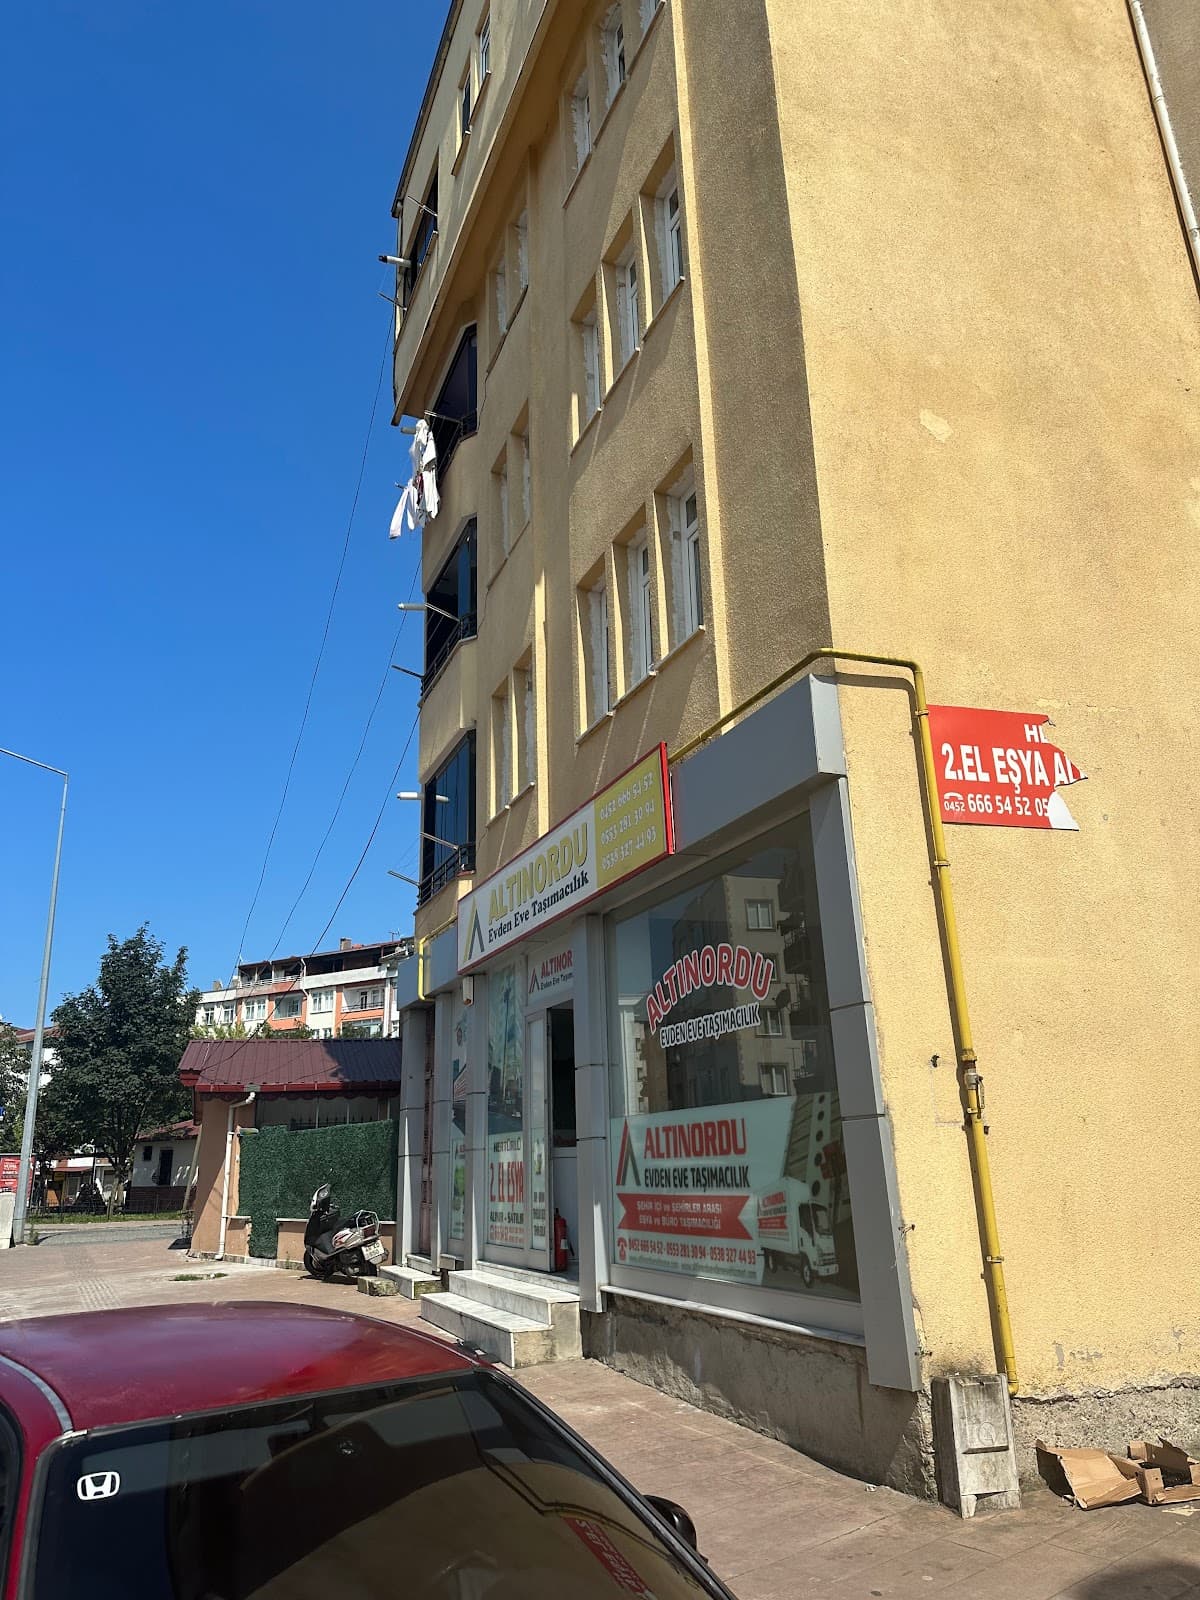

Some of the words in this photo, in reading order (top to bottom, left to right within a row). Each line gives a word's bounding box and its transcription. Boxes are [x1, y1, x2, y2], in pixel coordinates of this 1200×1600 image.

[941, 742, 990, 783] 2.EL
[991, 747, 1051, 794] EŞYA
[944, 801, 965, 812] 0452
[967, 793, 993, 814] 666
[995, 795, 1012, 815] 54
[1015, 797, 1032, 816] 52
[488, 822, 589, 926] ALTINORDU
[488, 919, 513, 943] Evden
[514, 910, 530, 929] Eve
[532, 870, 590, 914] Taşımacılık
[646, 943, 774, 1035] ALTINORDU
[660, 1021, 687, 1048] EVDEN
[687, 1017, 704, 1042] EVE
[703, 1002, 760, 1040] TAŞIMACILIK
[644, 1117, 747, 1159] ALTINORDU
[644, 1167, 671, 1188] EVDEN
[672, 1167, 689, 1188] EVE
[690, 1165, 750, 1192] TAŞIMACILIK
[666, 1241, 679, 1257] 0553
